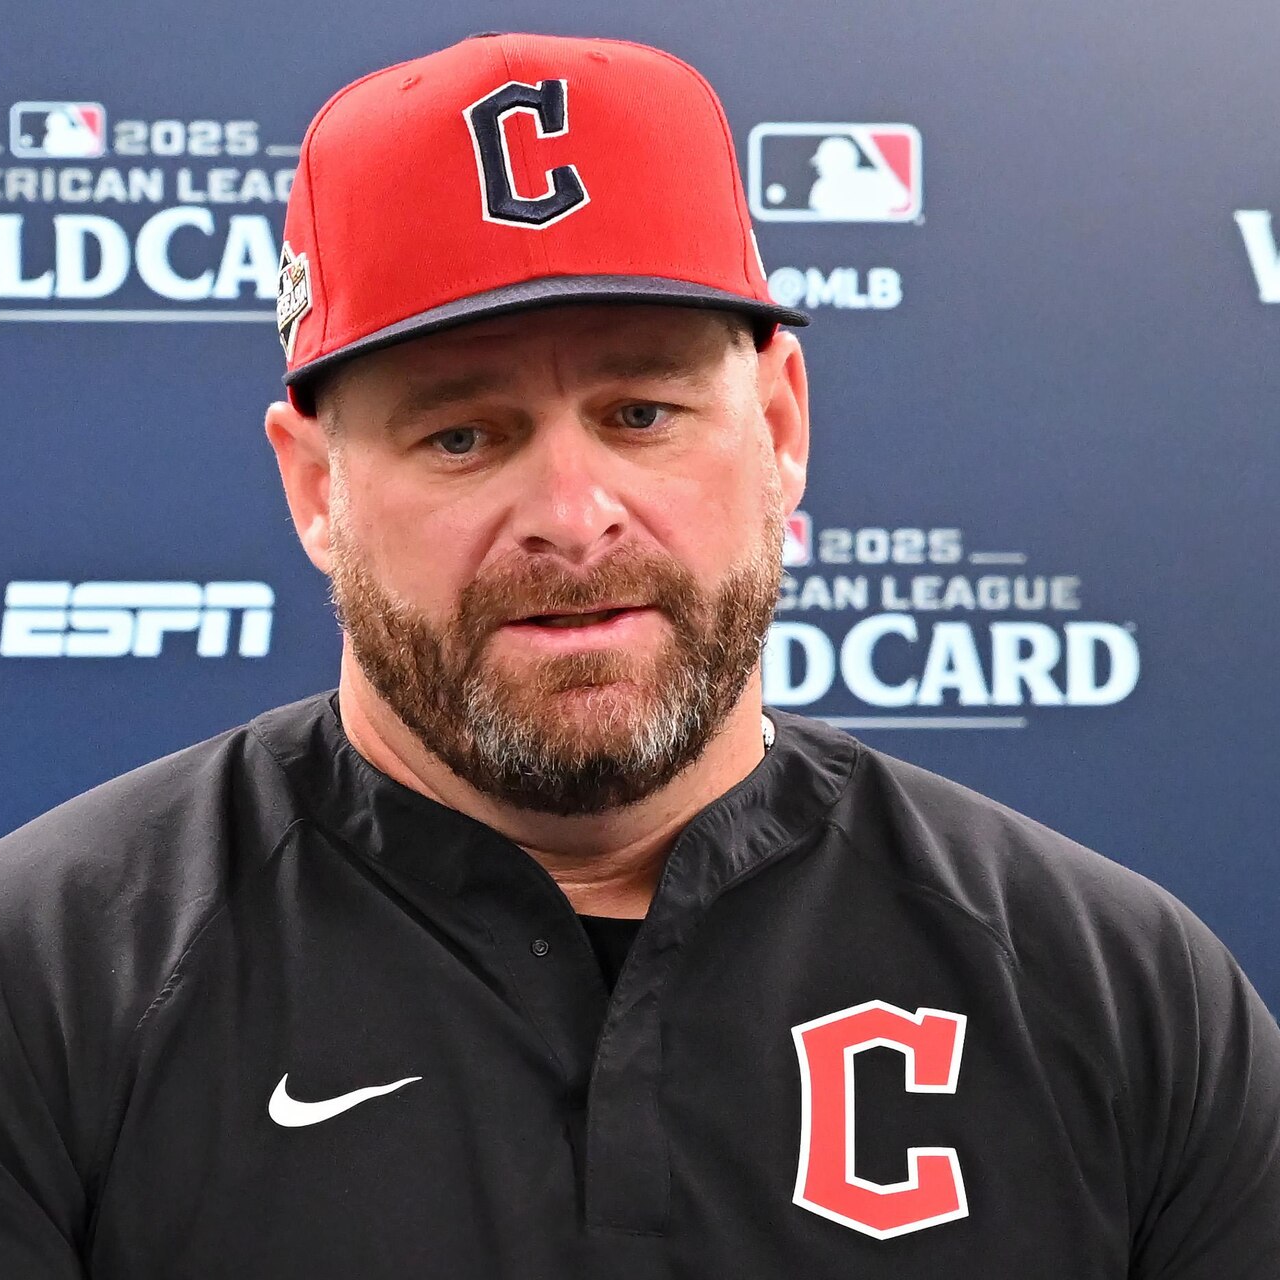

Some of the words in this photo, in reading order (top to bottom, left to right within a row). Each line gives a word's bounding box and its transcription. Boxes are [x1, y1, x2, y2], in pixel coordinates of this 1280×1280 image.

[115, 120, 258, 156] 2025
[463, 78, 590, 230] C
[768, 268, 902, 309] @MLB
[820, 529, 961, 563] 2025
[881, 575, 1080, 611] LEAGUE
[0, 582, 274, 657] ESPN
[791, 999, 969, 1240] C
